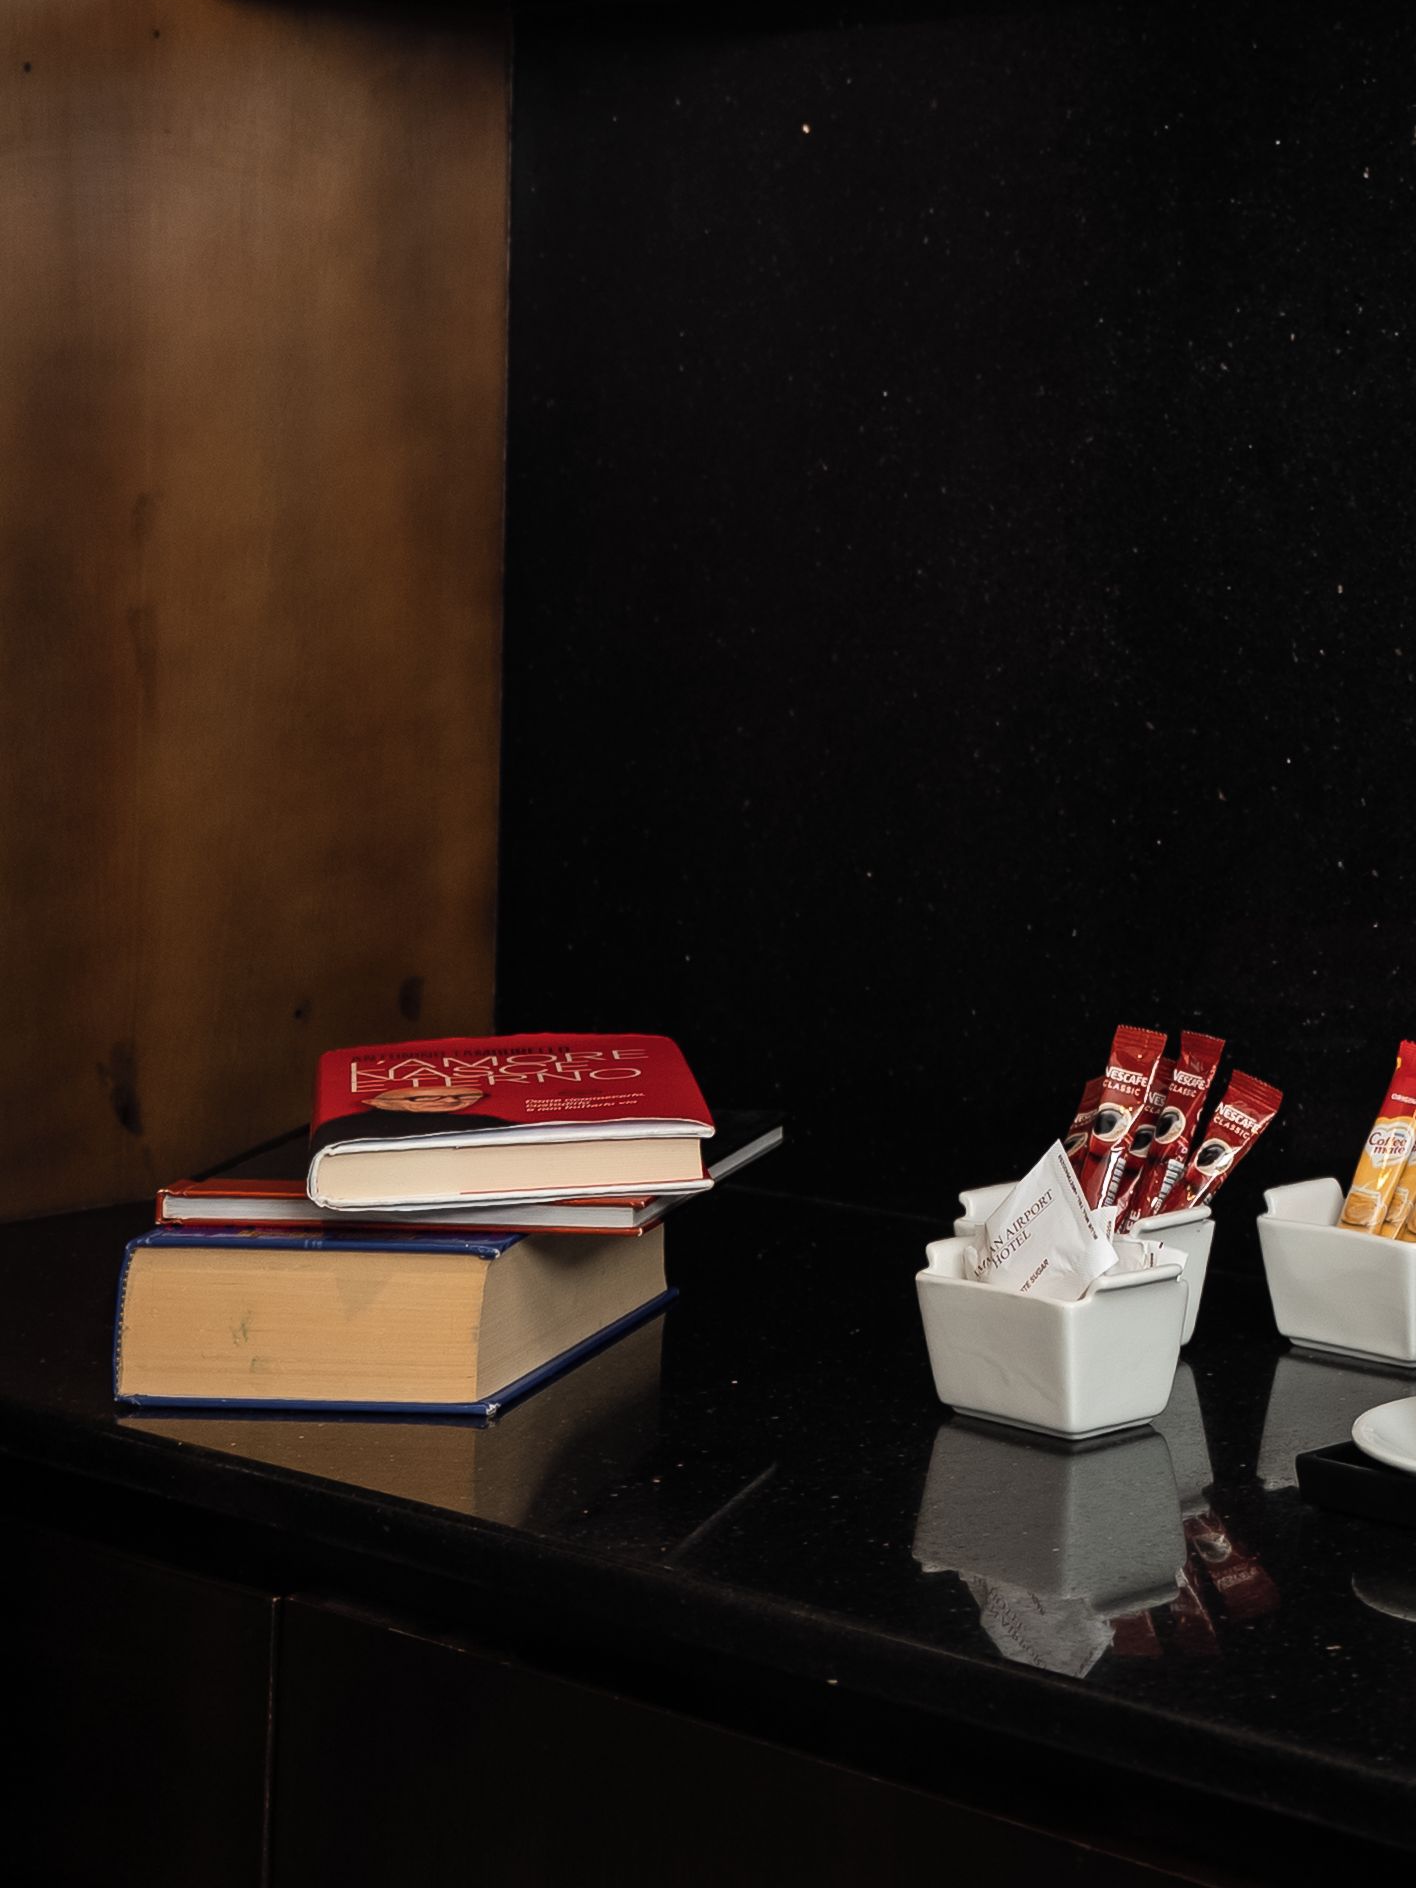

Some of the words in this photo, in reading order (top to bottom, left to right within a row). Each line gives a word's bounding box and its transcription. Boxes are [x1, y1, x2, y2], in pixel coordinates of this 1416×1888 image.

[1103, 1079, 1141, 1097] CLASSIC
[1169, 1083, 1198, 1098] CLASSIC
[1213, 1114, 1251, 1139] CLASSIC
[1006, 1189, 1053, 1240] AIRPORT
[993, 1230, 1032, 1269] HOTEL
[1030, 1259, 1049, 1283] SUGAR
